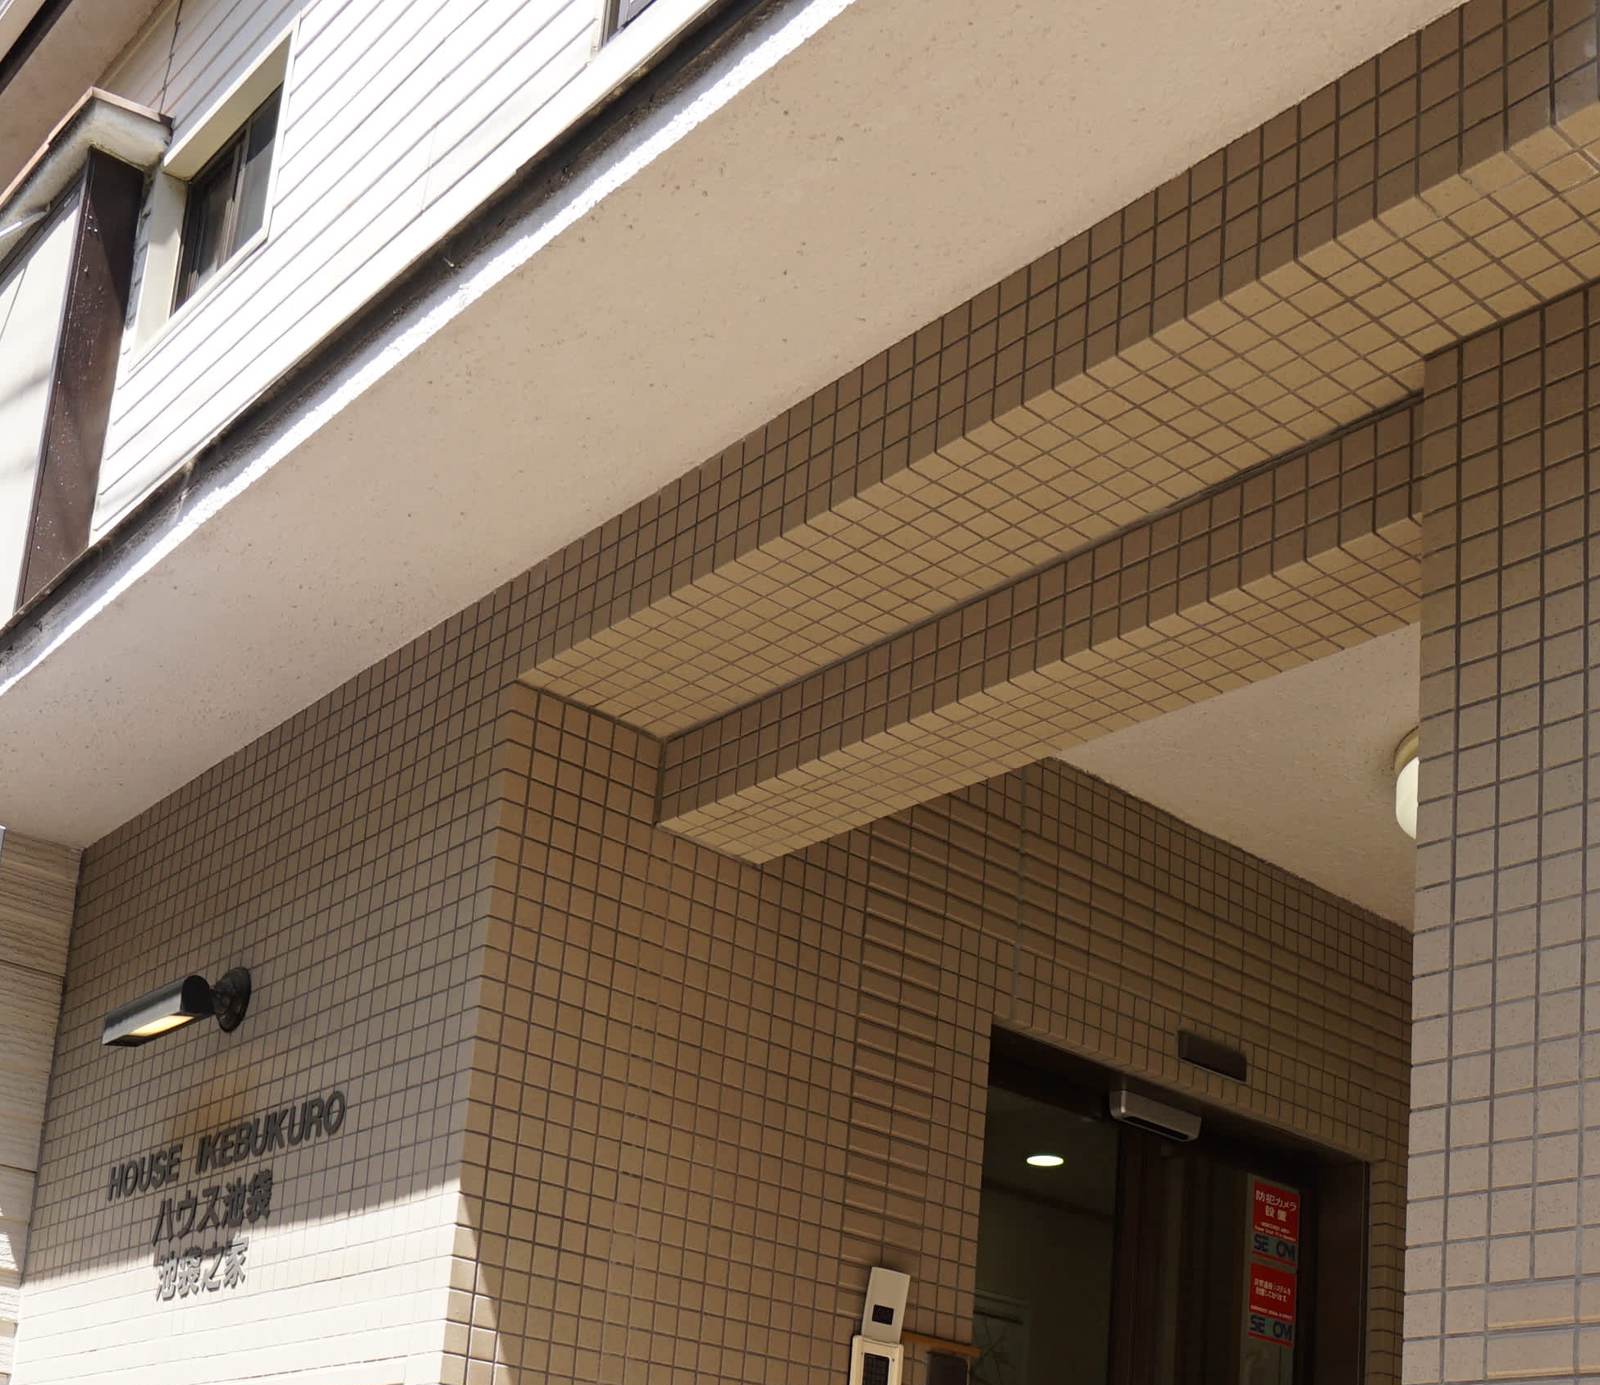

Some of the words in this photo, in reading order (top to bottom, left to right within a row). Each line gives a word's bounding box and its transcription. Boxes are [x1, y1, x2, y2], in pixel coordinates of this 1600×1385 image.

[108, 1143, 183, 1201] HOUSE
[195, 1090, 346, 1175] IKEBUKURO
[153, 1168, 273, 1246] ハウス池袋
[156, 1232, 250, 1301] 池袋之家
[1254, 1233, 1296, 1260] SEOM
[1250, 1314, 1293, 1340] SEOM
